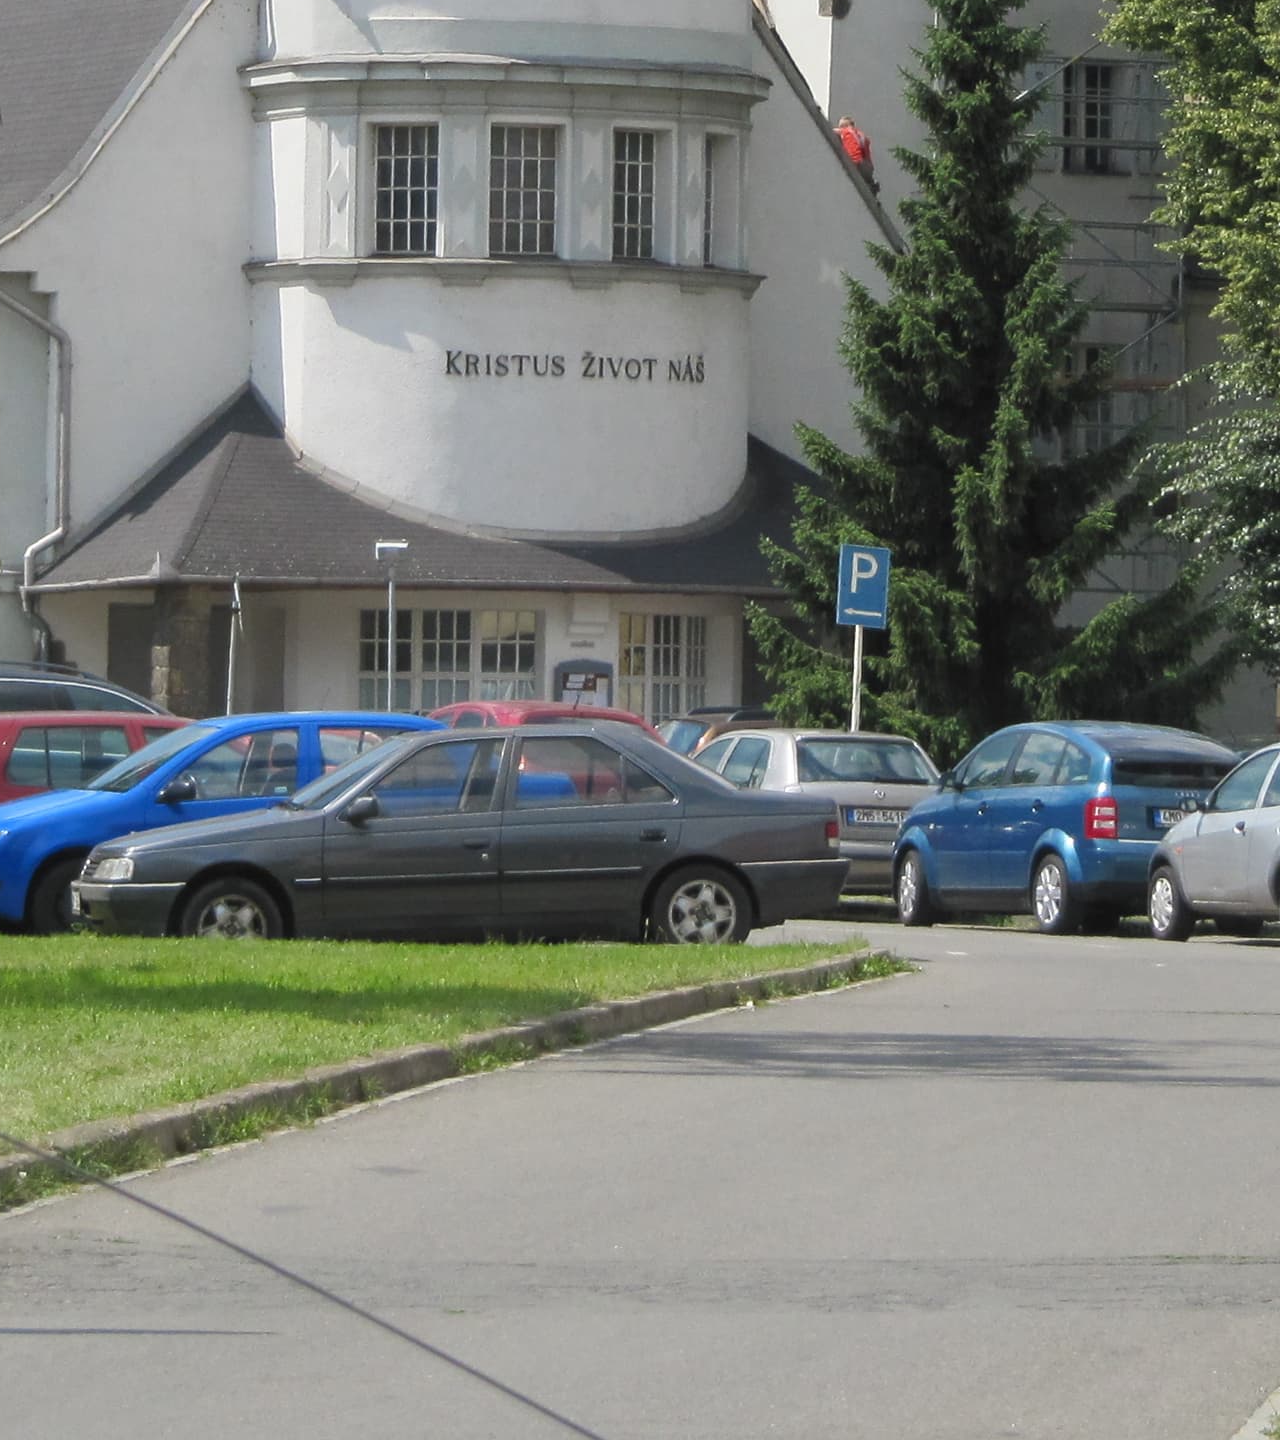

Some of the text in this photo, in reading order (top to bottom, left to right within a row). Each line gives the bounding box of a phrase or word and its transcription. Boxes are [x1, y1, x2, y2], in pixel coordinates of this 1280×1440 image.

[445, 349, 705, 384] KRISTUS ŽIVOT NÁŠ
[850, 551, 878, 594] P
